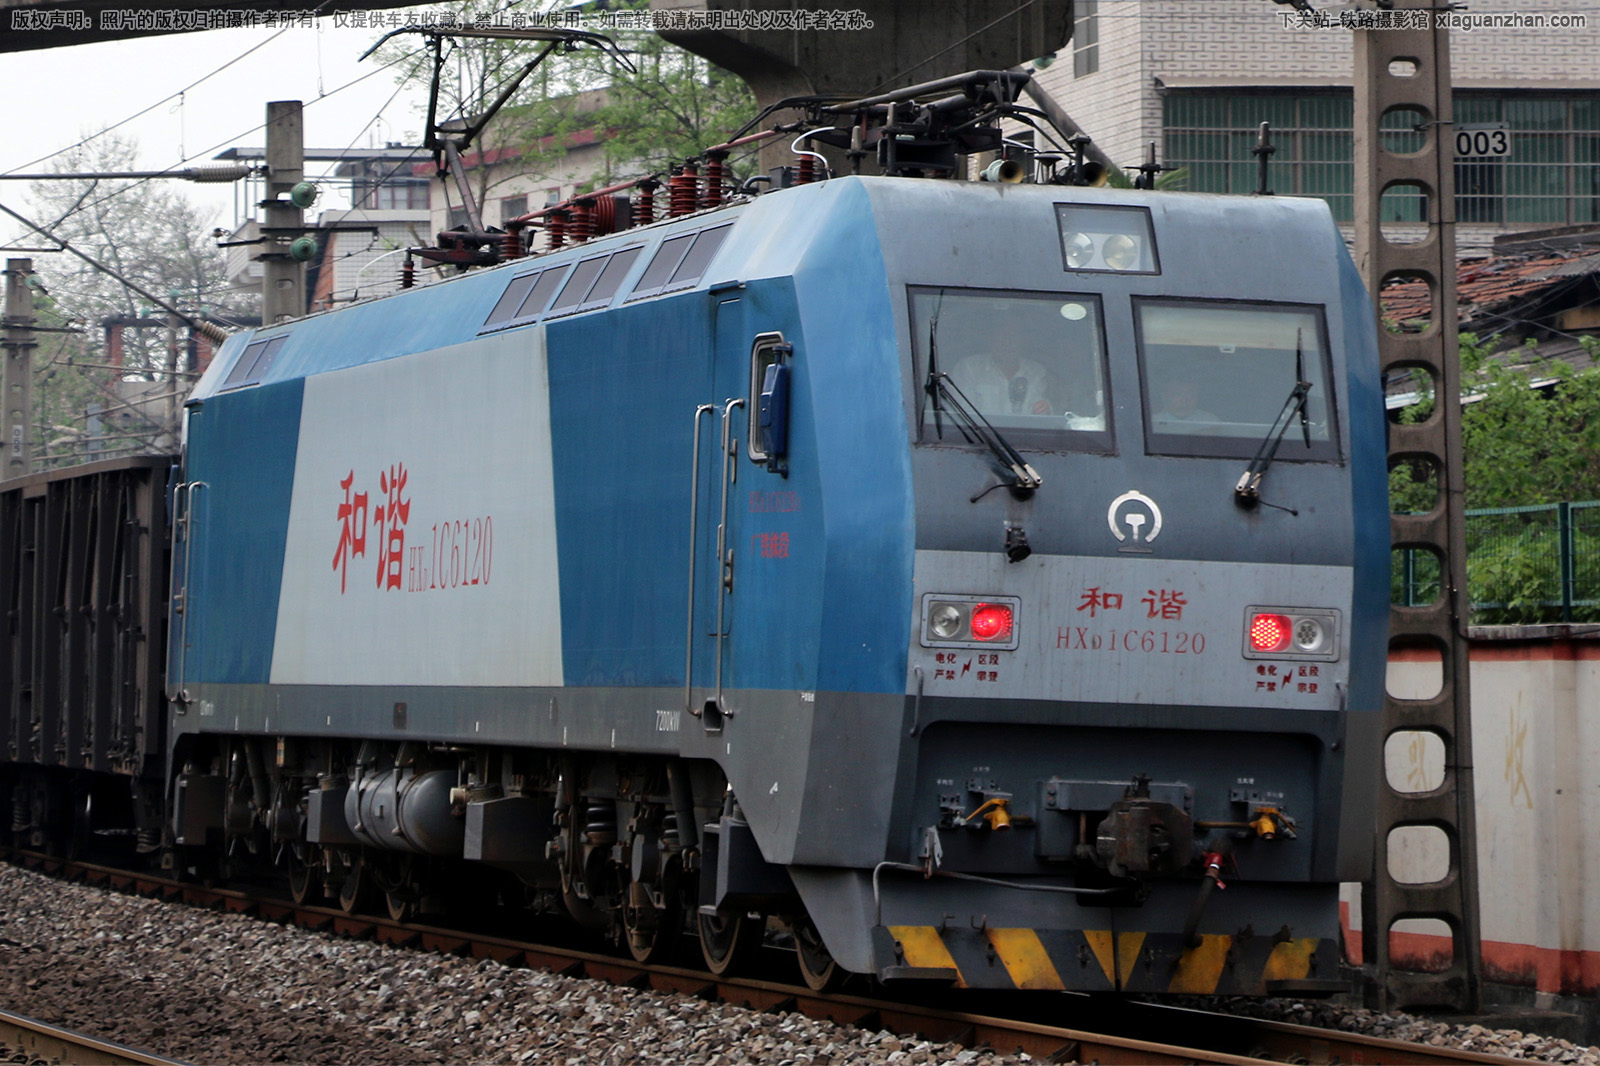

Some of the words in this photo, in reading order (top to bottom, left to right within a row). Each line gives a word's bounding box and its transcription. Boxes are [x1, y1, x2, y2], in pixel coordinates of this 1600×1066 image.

[1456, 131, 1508, 156] 003
[332, 461, 411, 596] 和谐
[1056, 626, 1206, 655] HXD1C6120
[935, 652, 957, 664] 电化
[978, 654, 999, 666] 区段
[934, 669, 955, 681] 严禁
[1298, 666, 1319, 677] 区段
[1255, 681, 1276, 693] 严禁
